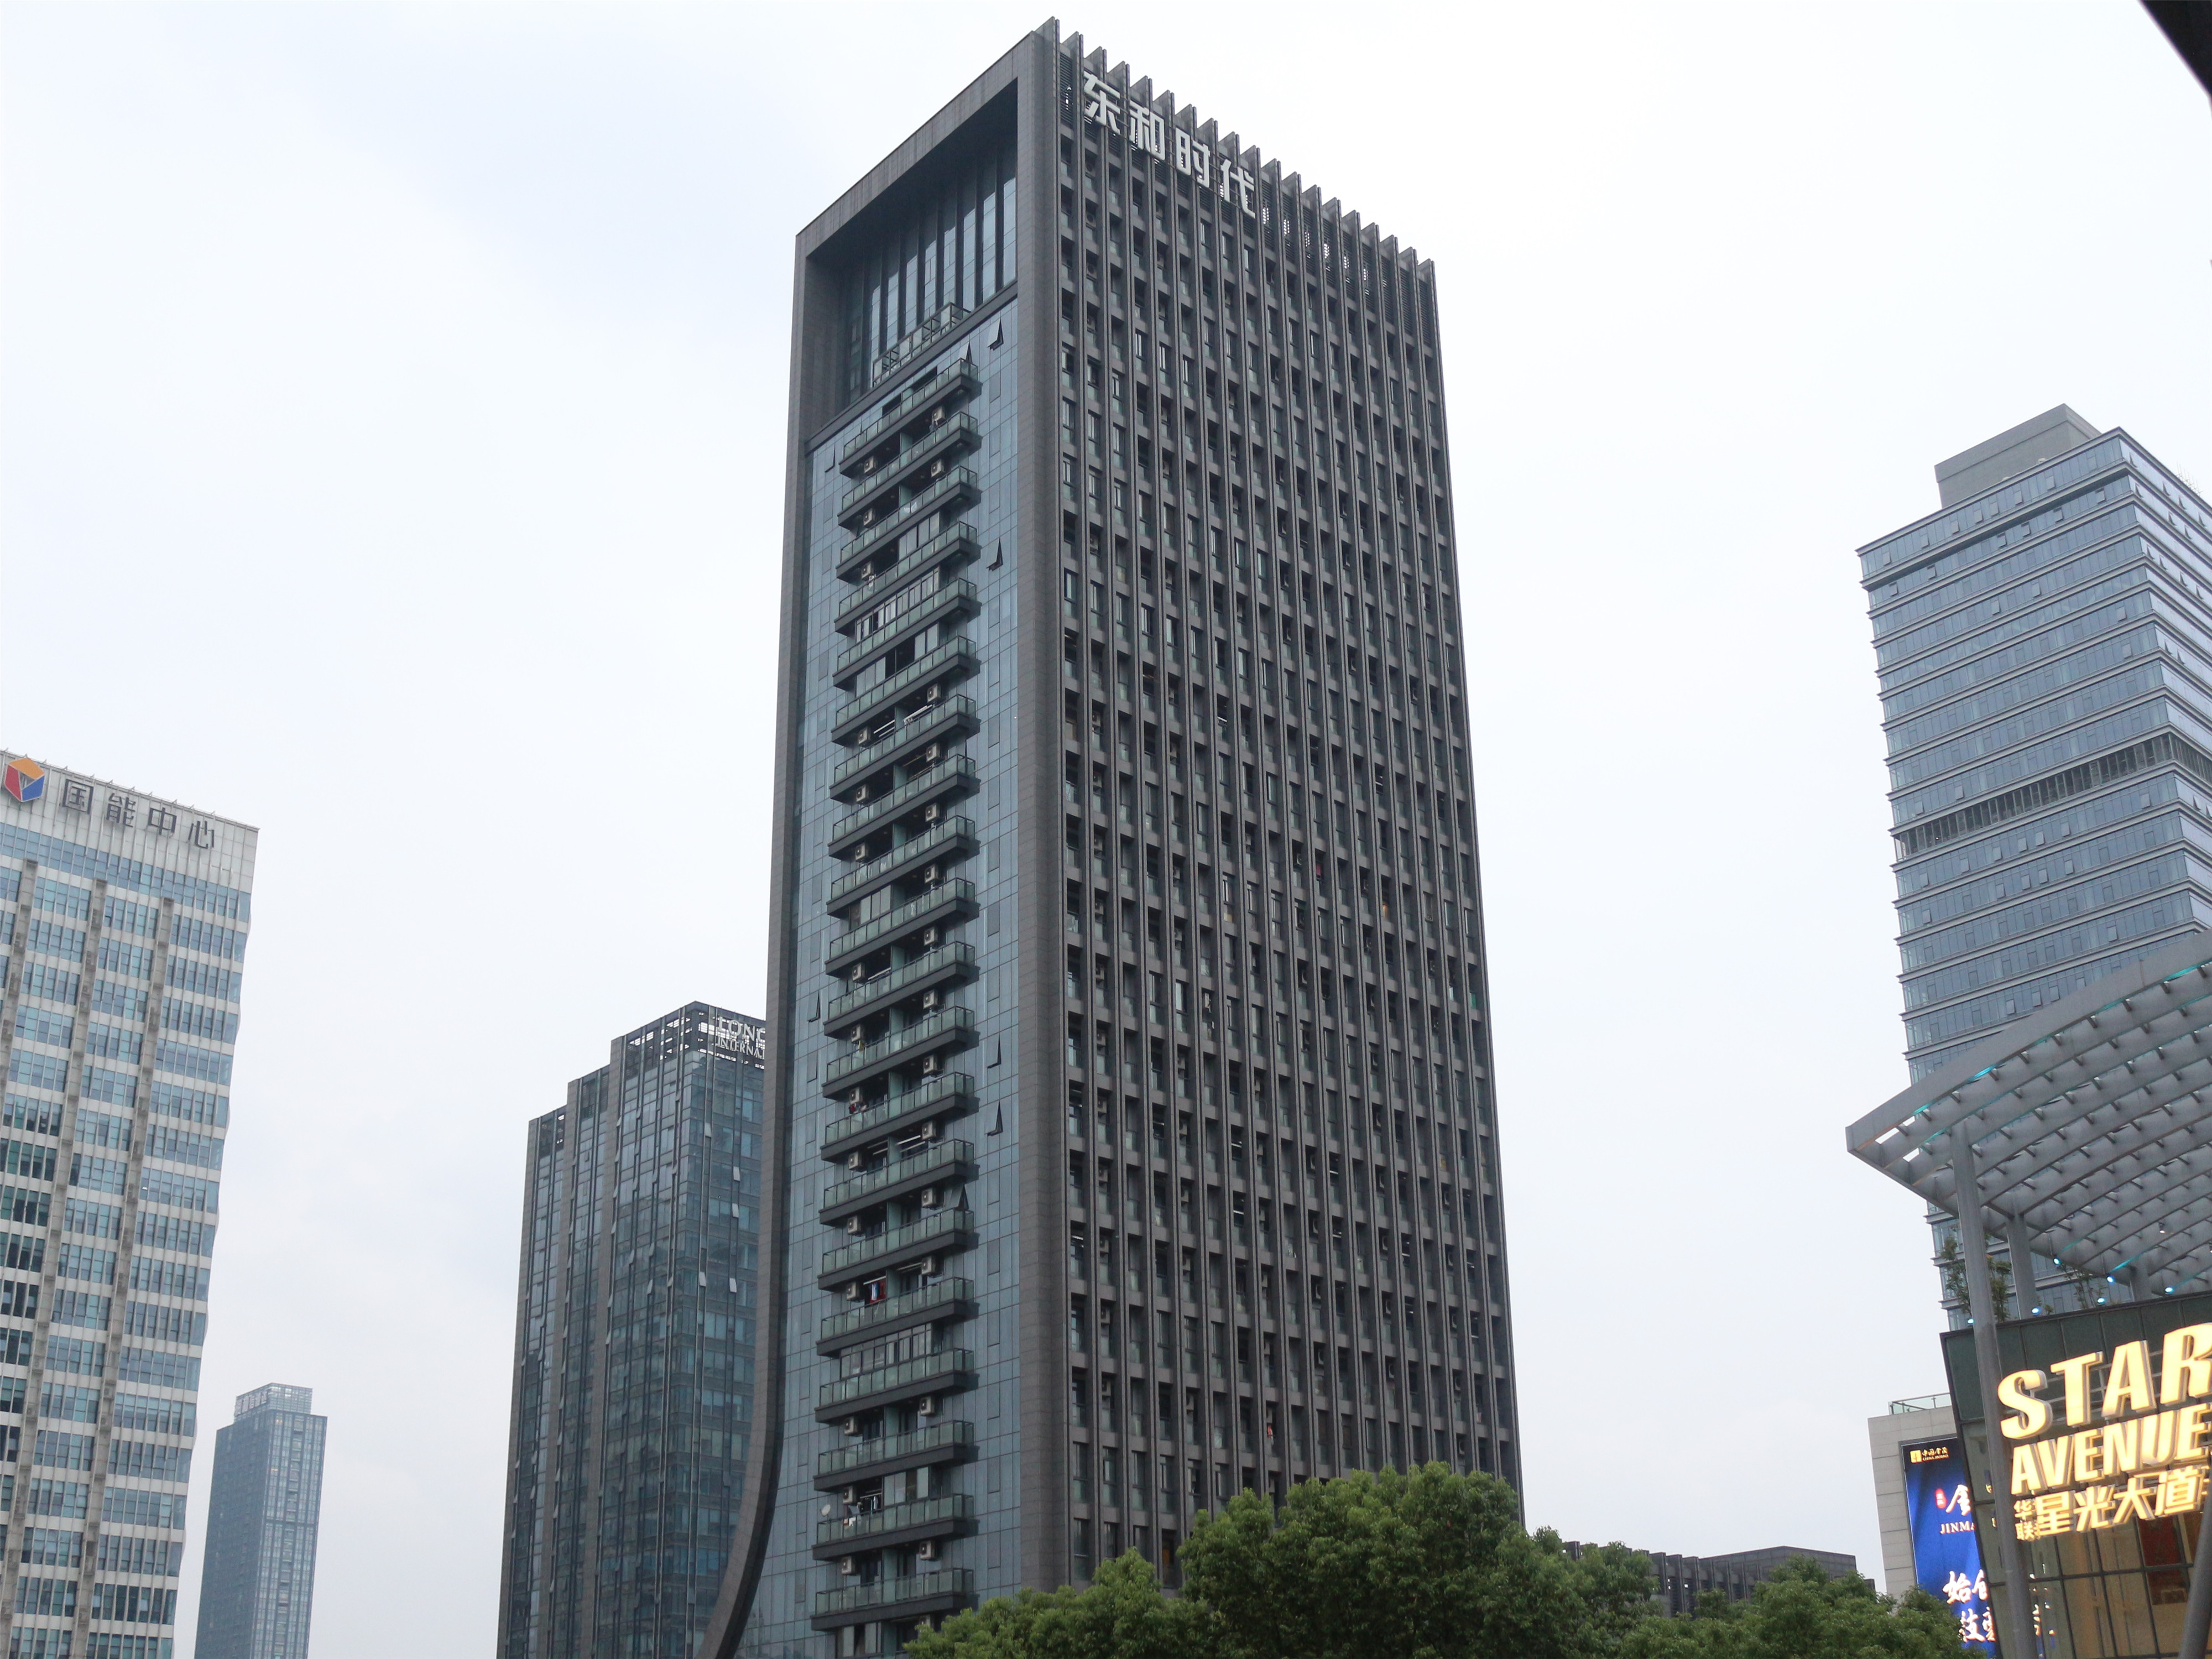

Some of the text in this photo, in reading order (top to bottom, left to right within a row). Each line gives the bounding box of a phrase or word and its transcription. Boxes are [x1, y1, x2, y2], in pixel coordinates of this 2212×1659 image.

[1083, 70, 1255, 218] 东和时代
[61, 779, 215, 849] 国能中心
[1997, 1322, 2212, 1439] STAR
[2011, 1402, 2210, 1495] AVENUE
[2013, 1500, 2035, 1541] 华联
[2036, 1468, 2200, 1536] 星光大道
